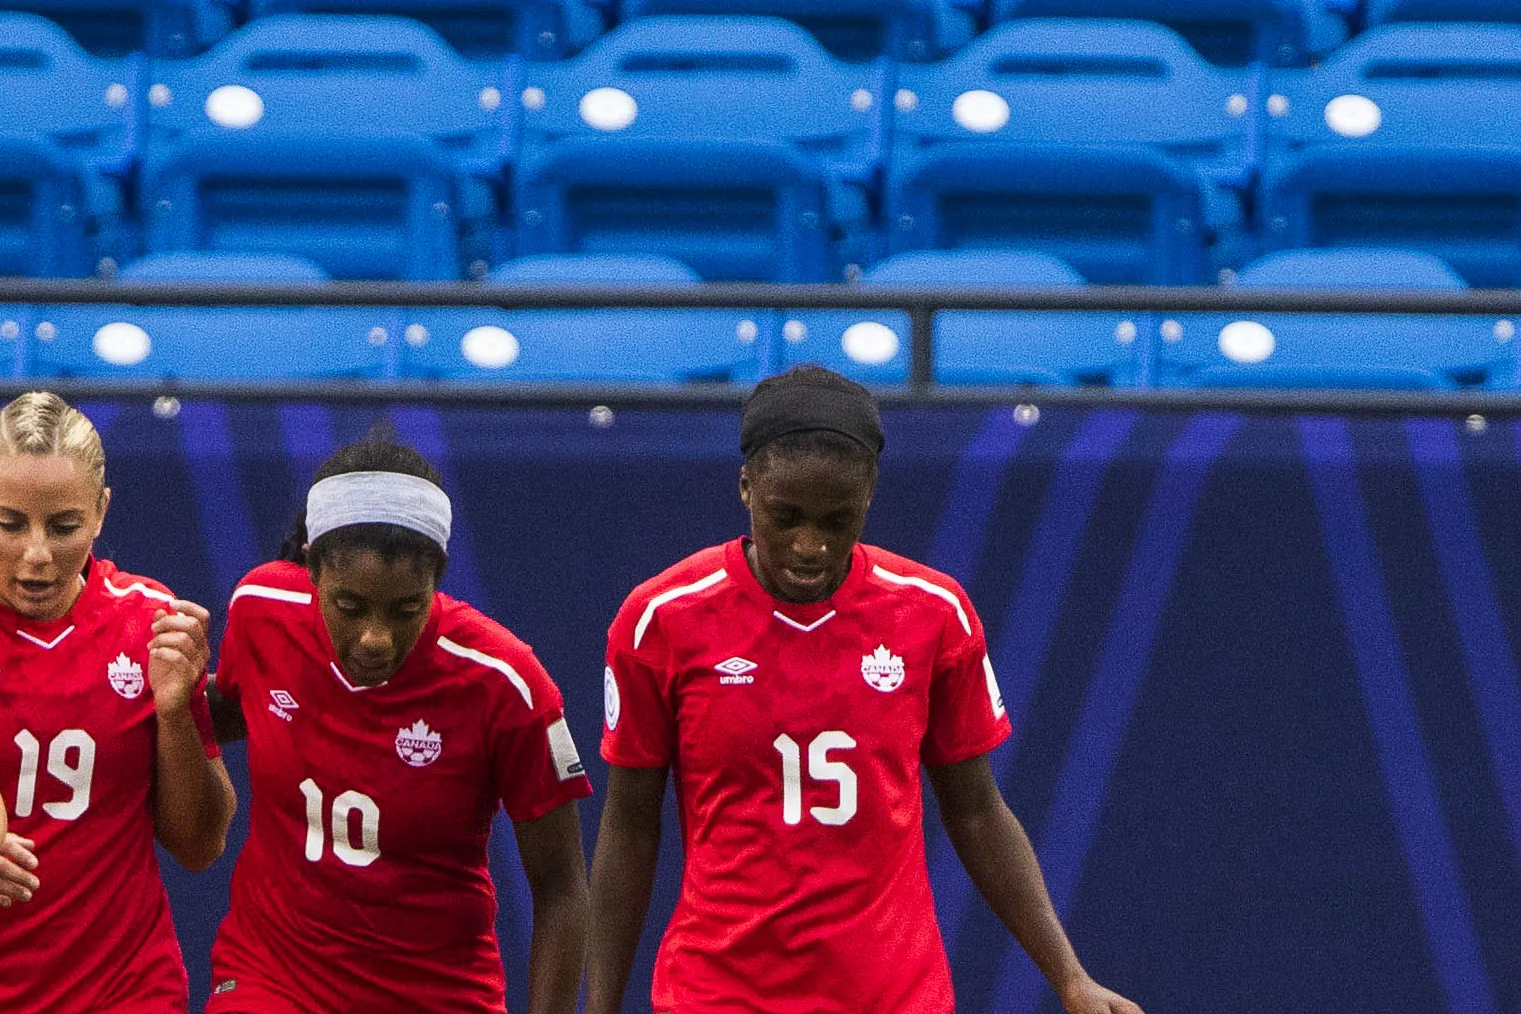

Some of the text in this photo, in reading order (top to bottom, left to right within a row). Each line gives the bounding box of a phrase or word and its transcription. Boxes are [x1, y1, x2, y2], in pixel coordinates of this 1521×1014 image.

[719, 675, 755, 685] umbro
[14, 728, 96, 821] 19
[395, 737, 442, 753] CANADA
[773, 730, 858, 826] 15
[299, 778, 381, 867] 10
